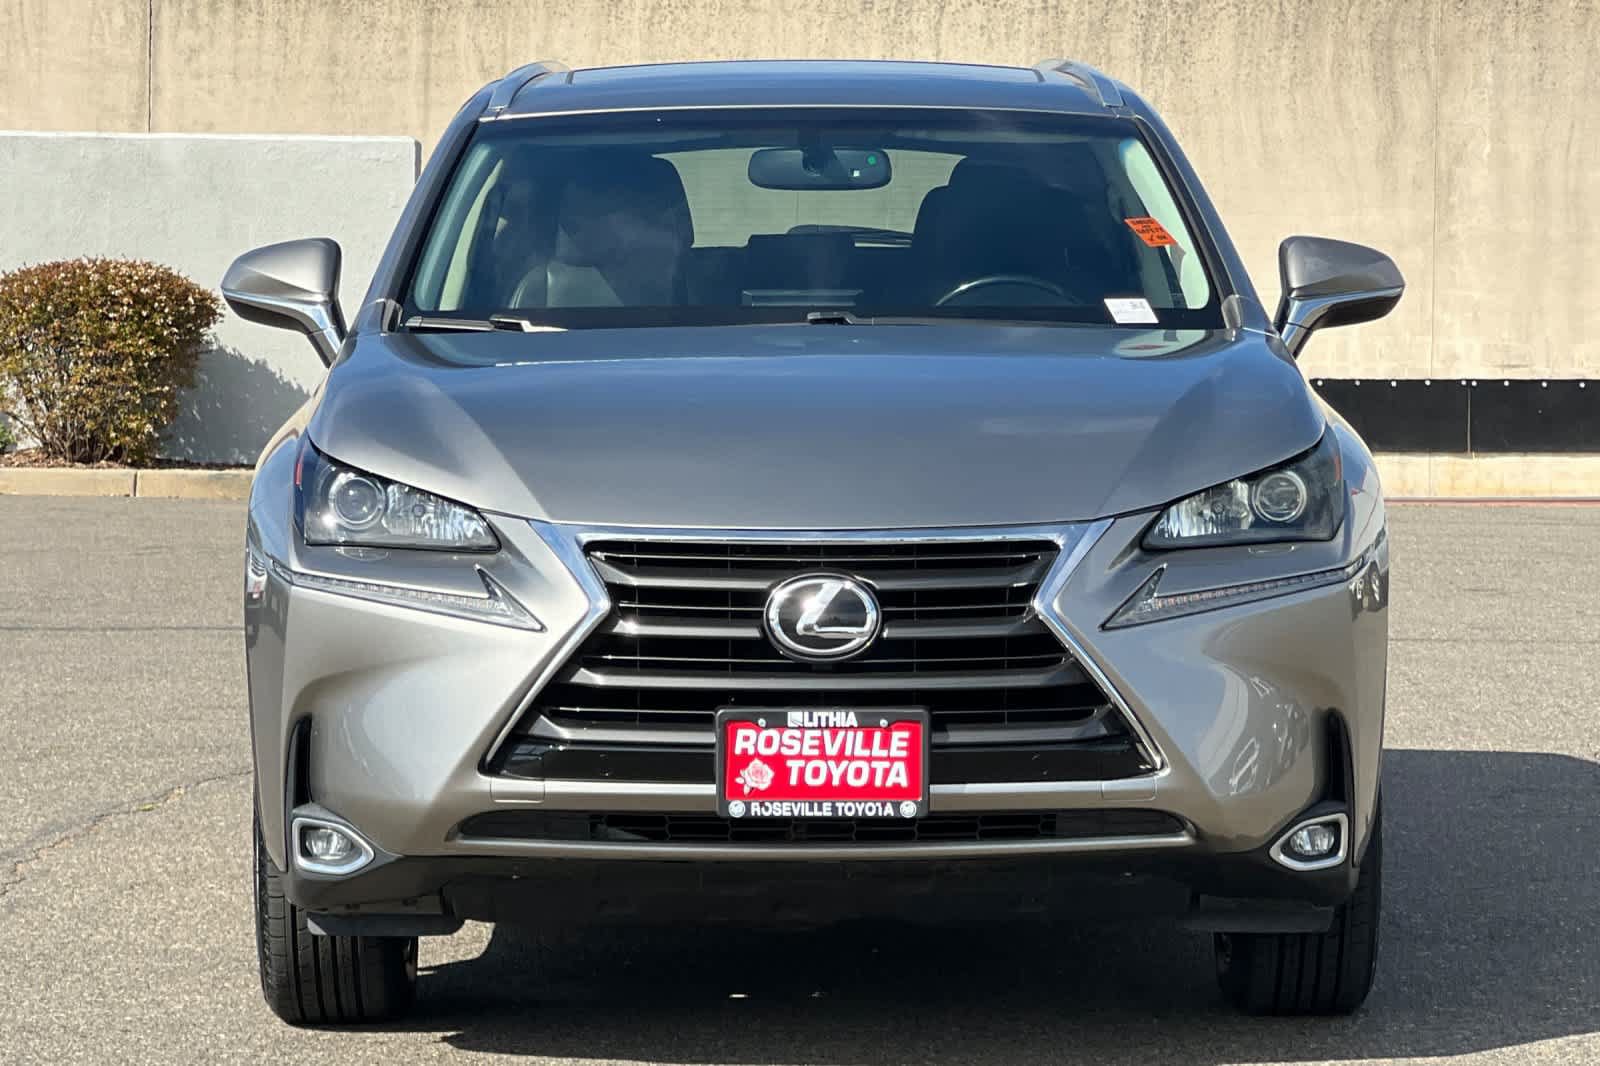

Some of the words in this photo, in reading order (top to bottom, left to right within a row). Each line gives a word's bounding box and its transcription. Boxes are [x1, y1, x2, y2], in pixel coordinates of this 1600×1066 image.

[803, 711, 858, 728] LITHIA
[734, 729, 910, 757] ROSEVILLE
[786, 760, 908, 788] TOYOTA
[750, 801, 833, 817] ROSEVILLE
[835, 801, 895, 817] TOYOTA
